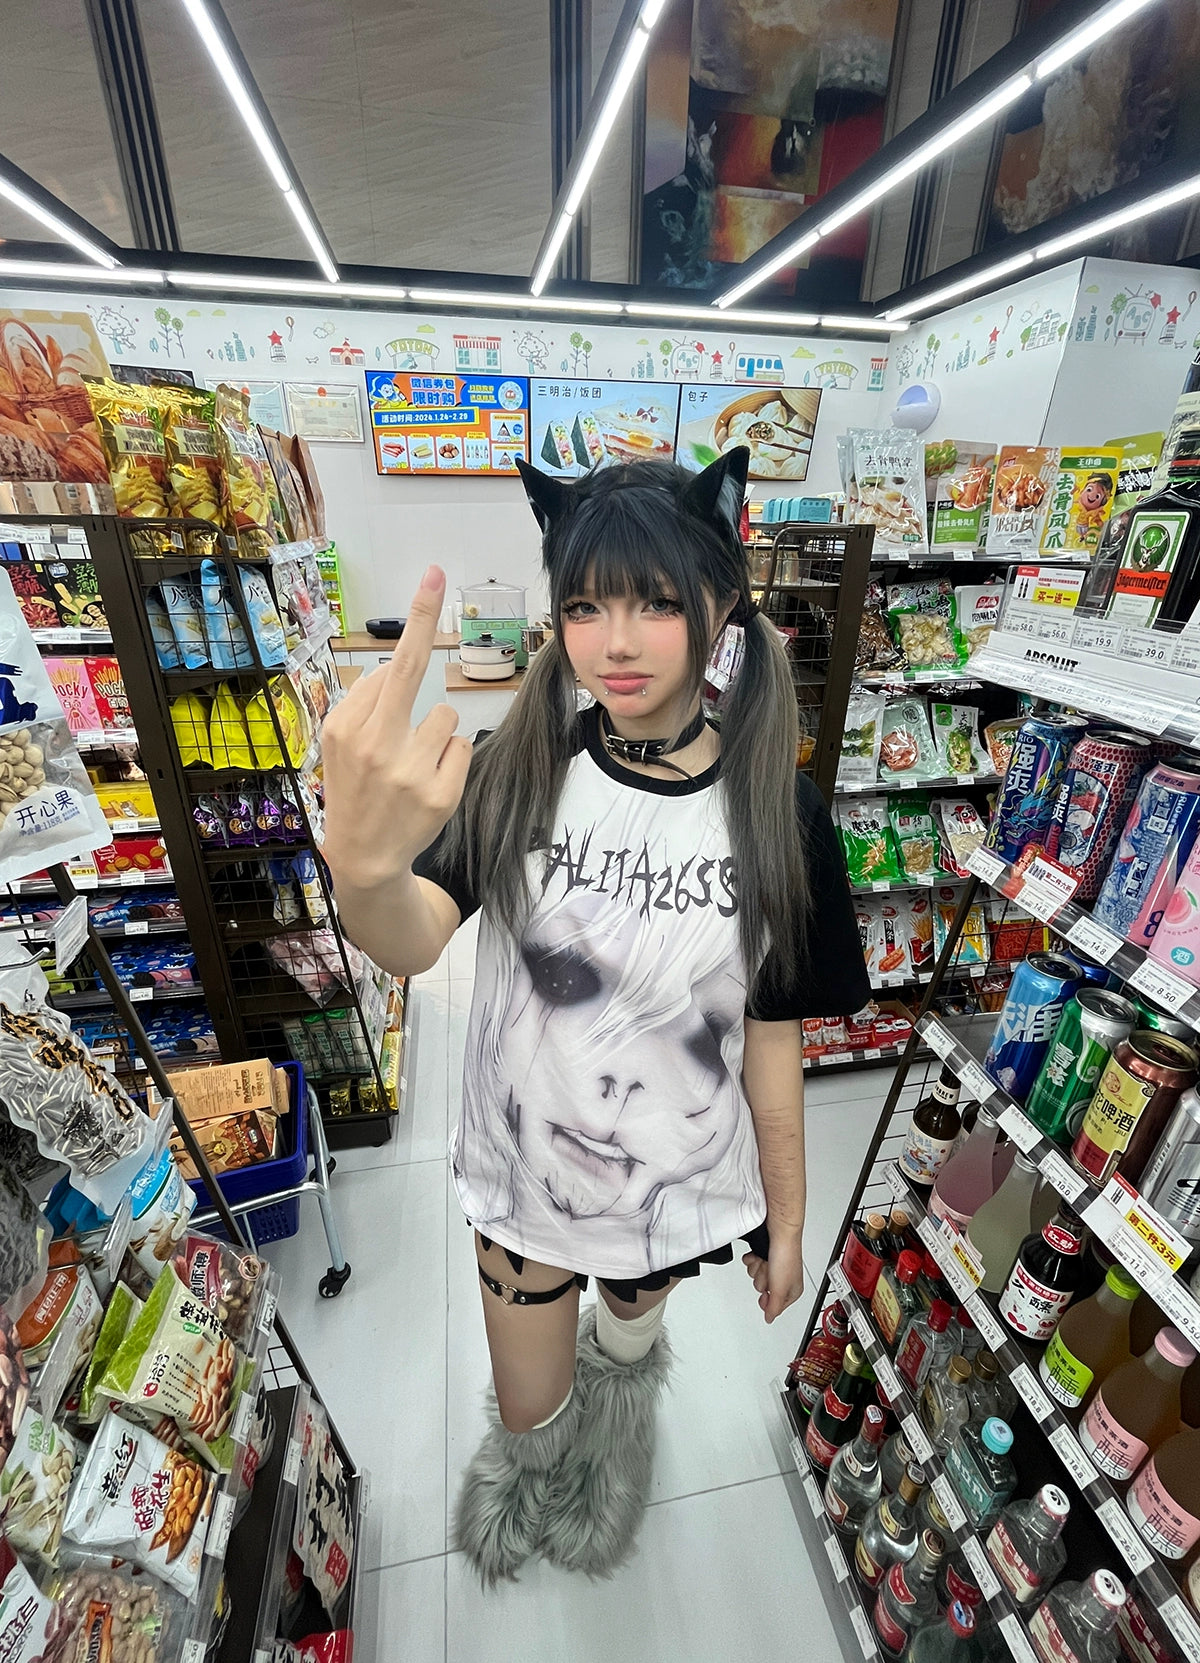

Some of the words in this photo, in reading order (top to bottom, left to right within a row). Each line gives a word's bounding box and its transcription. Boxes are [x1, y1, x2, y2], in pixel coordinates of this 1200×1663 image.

[411, 377, 455, 389] 微信券包
[412, 391, 455, 405] 限时购
[537, 386, 602, 399] 三明治/饭团
[687, 390, 709, 402] 包子
[1045, 473, 1074, 549] 去骨凤爪
[1037, 590, 1072, 604] 买一送一
[1095, 637, 1112, 647] 19.9
[1145, 648, 1164, 660] 39.0
[1018, 734, 1034, 743] RIO
[1006, 741, 1037, 795] 强爽
[15, 789, 74, 829] 开心果
[1090, 942, 1107, 955] 14.8
[1172, 949, 1192, 964] 酒
[1156, 987, 1176, 1003] 8.50
[1056, 1180, 1071, 1196] 10.0
[1128, 1212, 1177, 1266] 第二件3元
[1129, 1257, 1147, 1278] 11.8
[1120, 1539, 1137, 1562] 26.0
